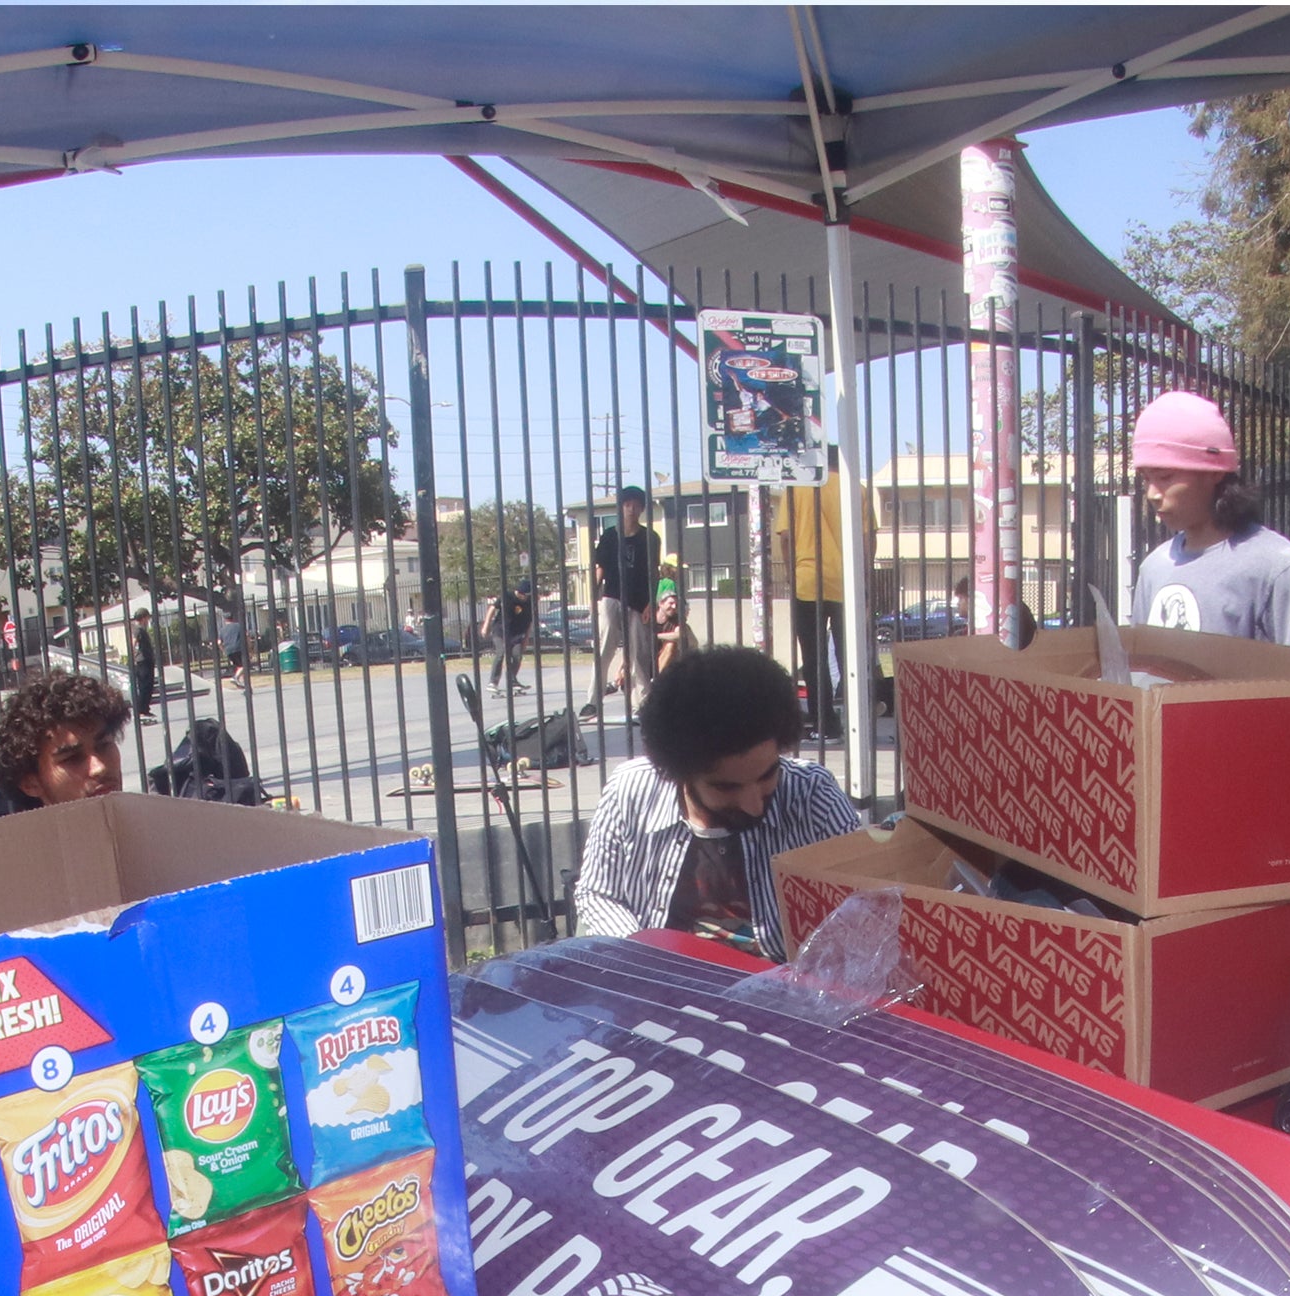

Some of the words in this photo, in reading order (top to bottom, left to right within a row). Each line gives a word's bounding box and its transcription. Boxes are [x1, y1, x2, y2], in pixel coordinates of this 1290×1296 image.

[906, 697, 935, 751] VANS
[924, 689, 956, 745] VANS
[943, 678, 978, 738] VANS
[966, 672, 1003, 731] VANS
[1096, 696, 1133, 749] VAN
[959, 730, 994, 792] VANS
[981, 723, 1020, 787] VANS
[1007, 715, 1047, 781] VANS
[1033, 705, 1077, 774] VANS
[1063, 695, 1113, 768] VANS
[919, 746, 950, 801] VANS
[936, 738, 971, 796] VANS
[1082, 758, 1131, 833] VANS
[997, 778, 1036, 845] VANS
[1023, 771, 1064, 841] VANS
[1051, 765, 1096, 836] VANS
[948, 938, 1007, 1004] VANS
[986, 933, 1049, 1001] VANS
[1030, 926, 1096, 996] VANS
[1075, 927, 1123, 981] VAN
[339, 976, 355, 996] 4
[201, 1013, 217, 1033] 4
[317, 1016, 400, 1074] RUFFLES
[1054, 983, 1119, 1058] VANS
[42, 1058, 59, 1081] 8
[477, 1039, 674, 1156] TOP
[192, 1080, 252, 1129] Lay's
[351, 1120, 391, 1141] ORIGINAL
[13, 1100, 124, 1208] Fritos
[63, 1165, 94, 1193] BRAND
[198, 1152, 223, 1166] Sour
[224, 1140, 258, 1158] Cream
[210, 1160, 219, 1172] &
[220, 1152, 250, 1169] Onion
[55, 1237, 73, 1252] The
[74, 1192, 126, 1244] ORIGINAL
[336, 1180, 419, 1260] Cheetos
[367, 1220, 405, 1256] Crunchy
[270, 1277, 295, 1291] NACHO
